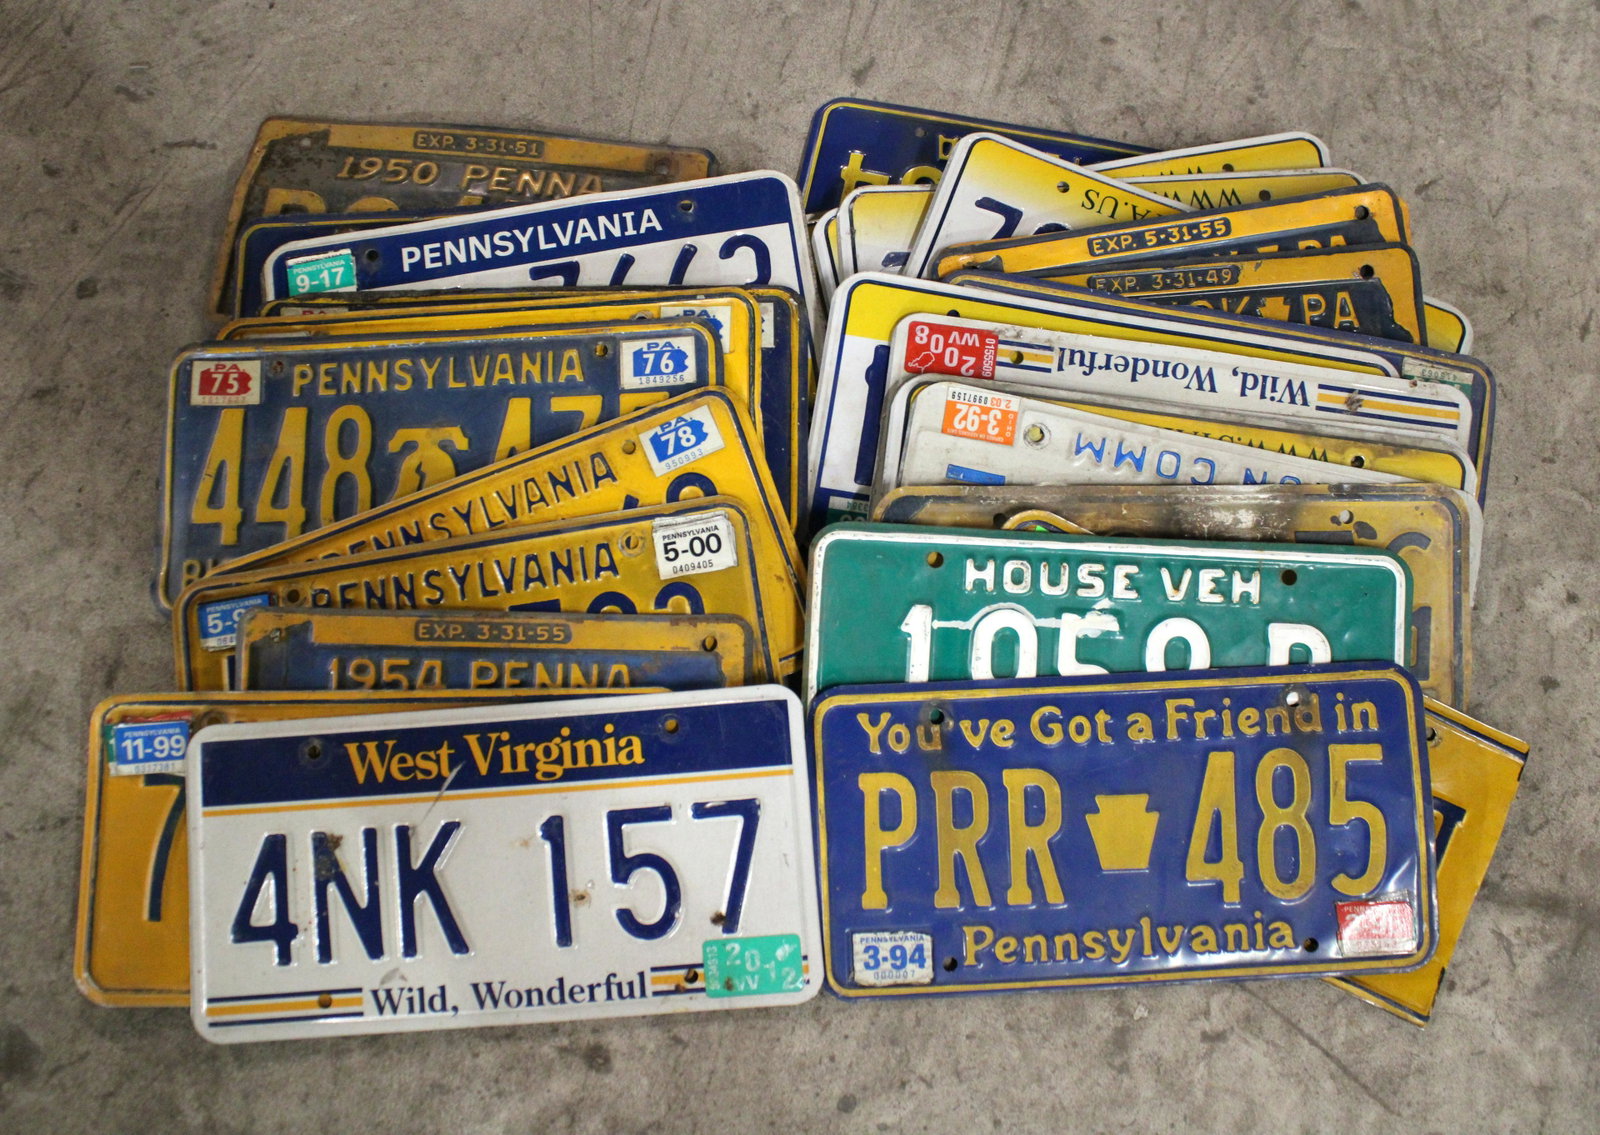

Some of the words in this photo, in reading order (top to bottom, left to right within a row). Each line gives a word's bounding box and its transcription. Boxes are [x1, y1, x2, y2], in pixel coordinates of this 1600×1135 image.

[416, 133, 456, 150] EXP.
[336, 155, 440, 186] 1950
[461, 163, 604, 197] PENNA
[401, 208, 663, 273] PENNSYLVANIA
[1092, 235, 1137, 254] EXP.
[296, 267, 344, 293] 9-17
[1095, 277, 1140, 291] EXP.
[1302, 291, 1361, 330] PA
[646, 341, 681, 350] PA.
[948, 330, 981, 347] WV
[292, 349, 584, 397] PENNSYLVANIA
[642, 352, 675, 375] 76
[1057, 347, 1218, 394] Wonderful
[210, 373, 240, 394] 75
[1232, 366, 1310, 407] Wild,
[953, 404, 1002, 435] 3-92
[660, 425, 696, 456] 78
[190, 404, 373, 545] 448
[1074, 432, 1217, 485] COMM
[321, 450, 617, 557] NNSYLVANIA
[662, 525, 720, 541] PENNSYLVANIA
[663, 532, 722, 562] 5-00
[311, 543, 620, 609] PENNSYLVANIA
[672, 560, 714, 574] 0409405
[964, 557, 1139, 599] HOUSE
[1160, 566, 1261, 604] VEH
[418, 622, 465, 640] EXP.
[477, 623, 566, 642] 3-31-55
[329, 658, 446, 690] 1954
[471, 659, 632, 690] PENNA
[1030, 706, 1115, 746] Got
[1127, 713, 1155, 743] a
[1165, 692, 1323, 739] Friend
[1336, 692, 1380, 732] in
[121, 735, 187, 761] 11-99
[344, 739, 455, 785] West
[464, 722, 646, 782] Virginia
[858, 768, 1066, 910] PRR
[1186, 742, 1388, 904] 485
[231, 820, 469, 966] 4NK
[539, 797, 761, 948] 157
[860, 935, 925, 944] PENNSYLVANIA
[962, 911, 1296, 967] Pennsylvania
[863, 943, 927, 971] 3-94
[370, 985, 459, 1019] Wild,
[471, 971, 648, 1010] Wonderful
